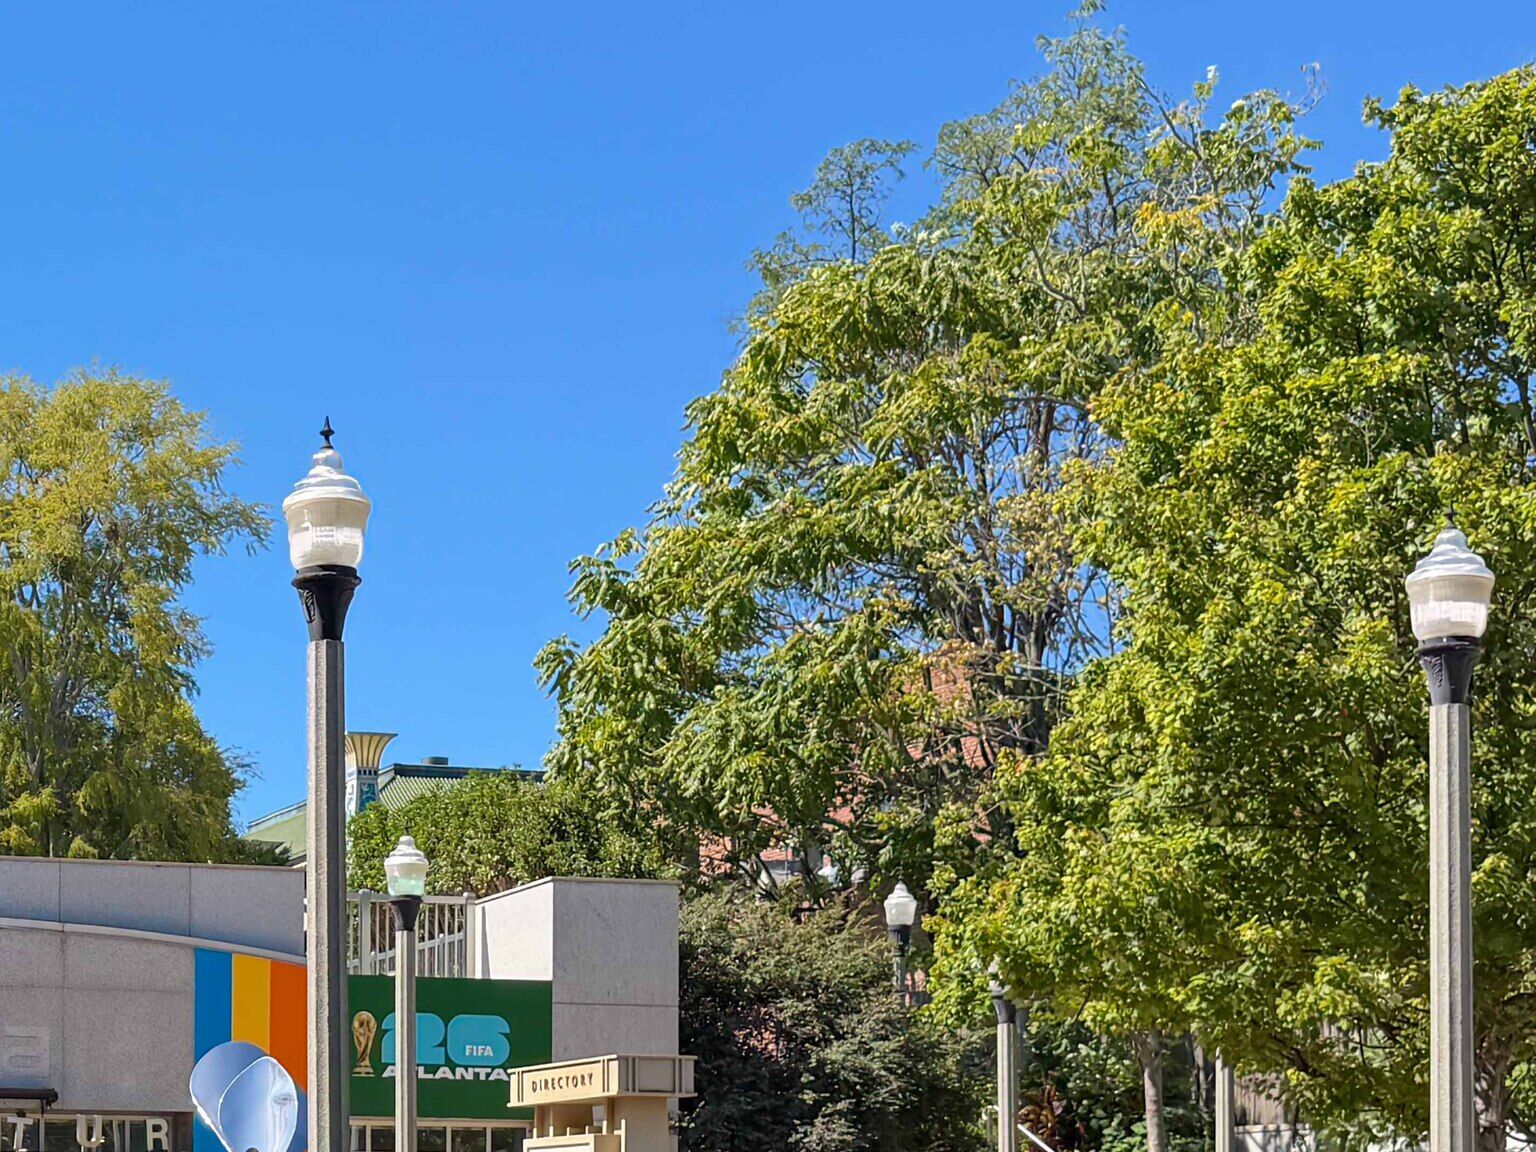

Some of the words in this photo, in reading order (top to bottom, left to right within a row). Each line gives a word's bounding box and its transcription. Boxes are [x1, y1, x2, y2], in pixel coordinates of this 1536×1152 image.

[381, 1012, 511, 1067] 26
[465, 1044, 494, 1057] FIFA
[381, 1065, 510, 1081] ALANTA
[531, 1072, 594, 1093] DIRECTORY
